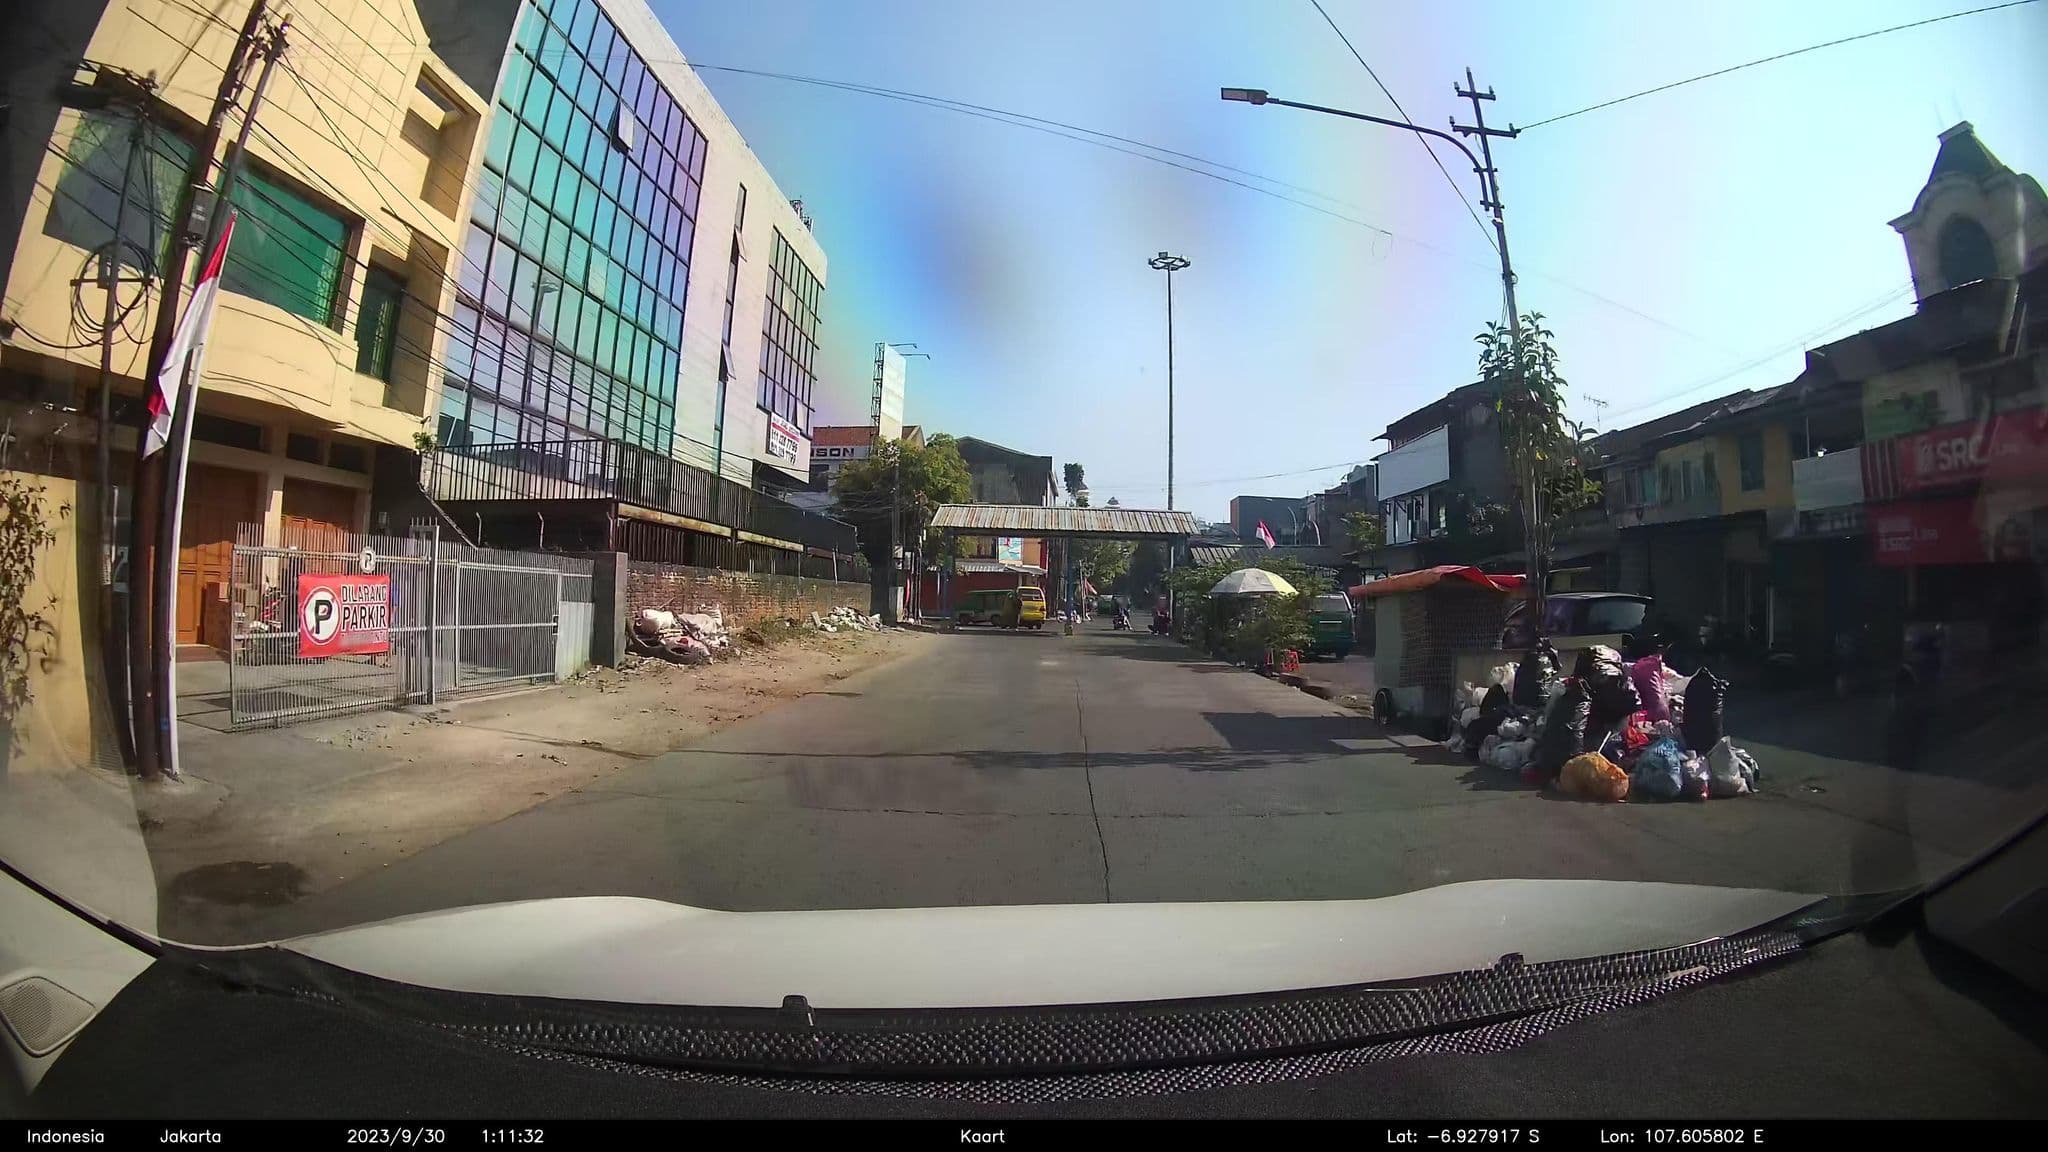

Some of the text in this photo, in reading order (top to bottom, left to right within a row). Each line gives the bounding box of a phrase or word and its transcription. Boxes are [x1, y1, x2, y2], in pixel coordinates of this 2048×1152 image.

[1936, 433, 1991, 472] SRC
[341, 585, 387, 603] DILARANG
[314, 599, 333, 635] P
[341, 604, 387, 630] PARKIR
